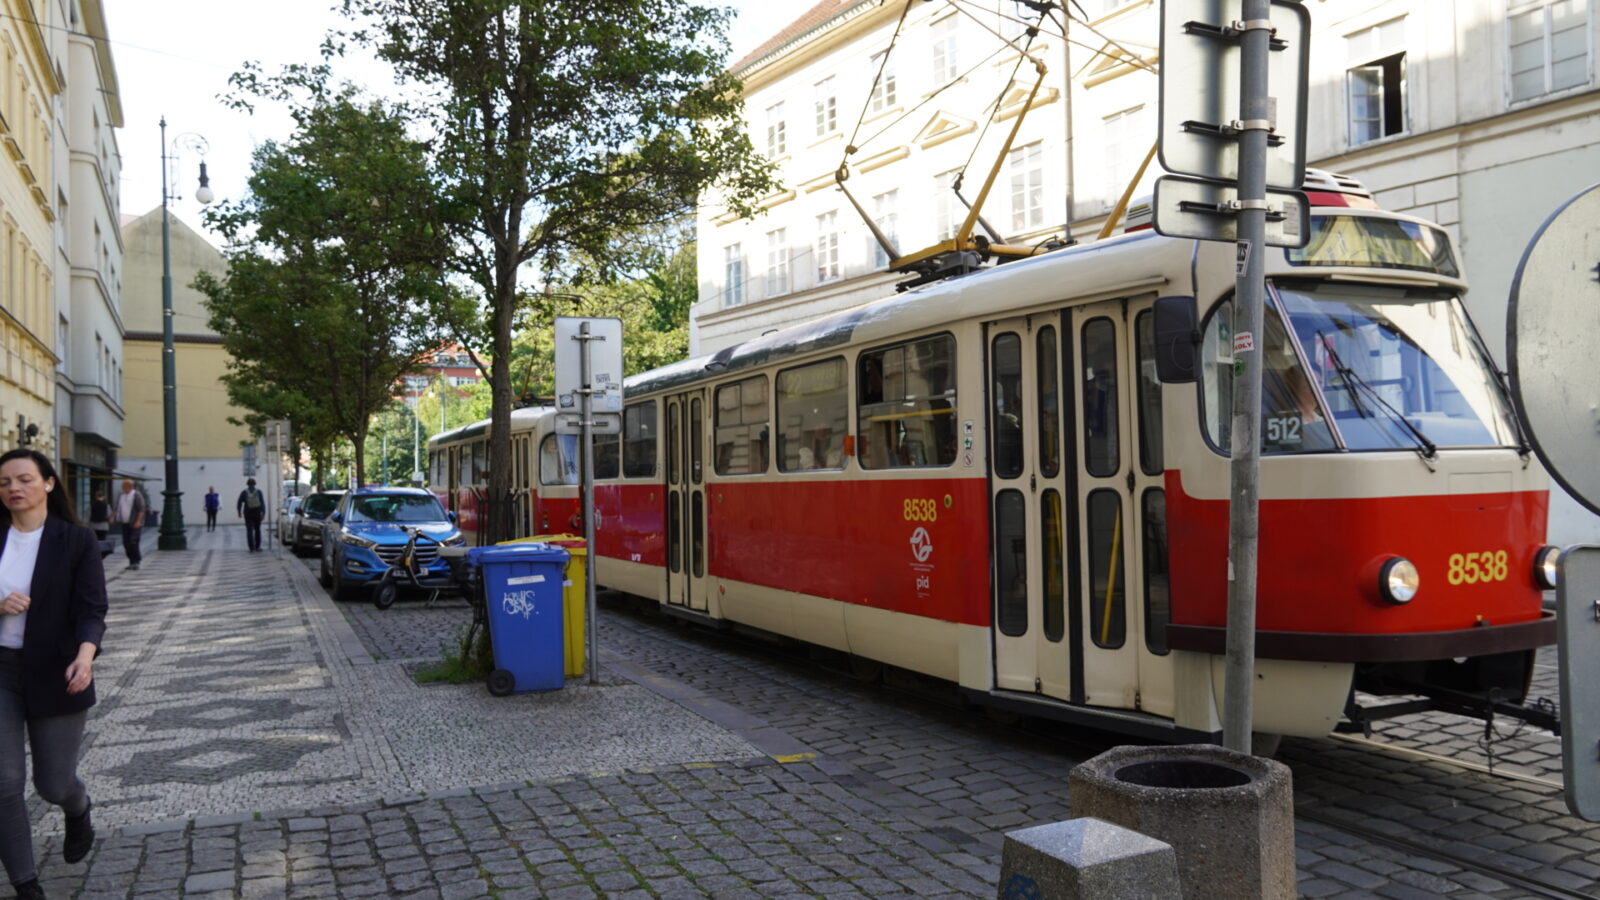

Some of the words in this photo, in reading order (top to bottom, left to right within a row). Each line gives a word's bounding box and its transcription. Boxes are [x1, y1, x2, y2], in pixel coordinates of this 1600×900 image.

[1266, 416, 1302, 442] 512
[903, 498, 937, 522] 8538
[1447, 549, 1509, 586] 8538
[916, 575, 930, 591] pid
